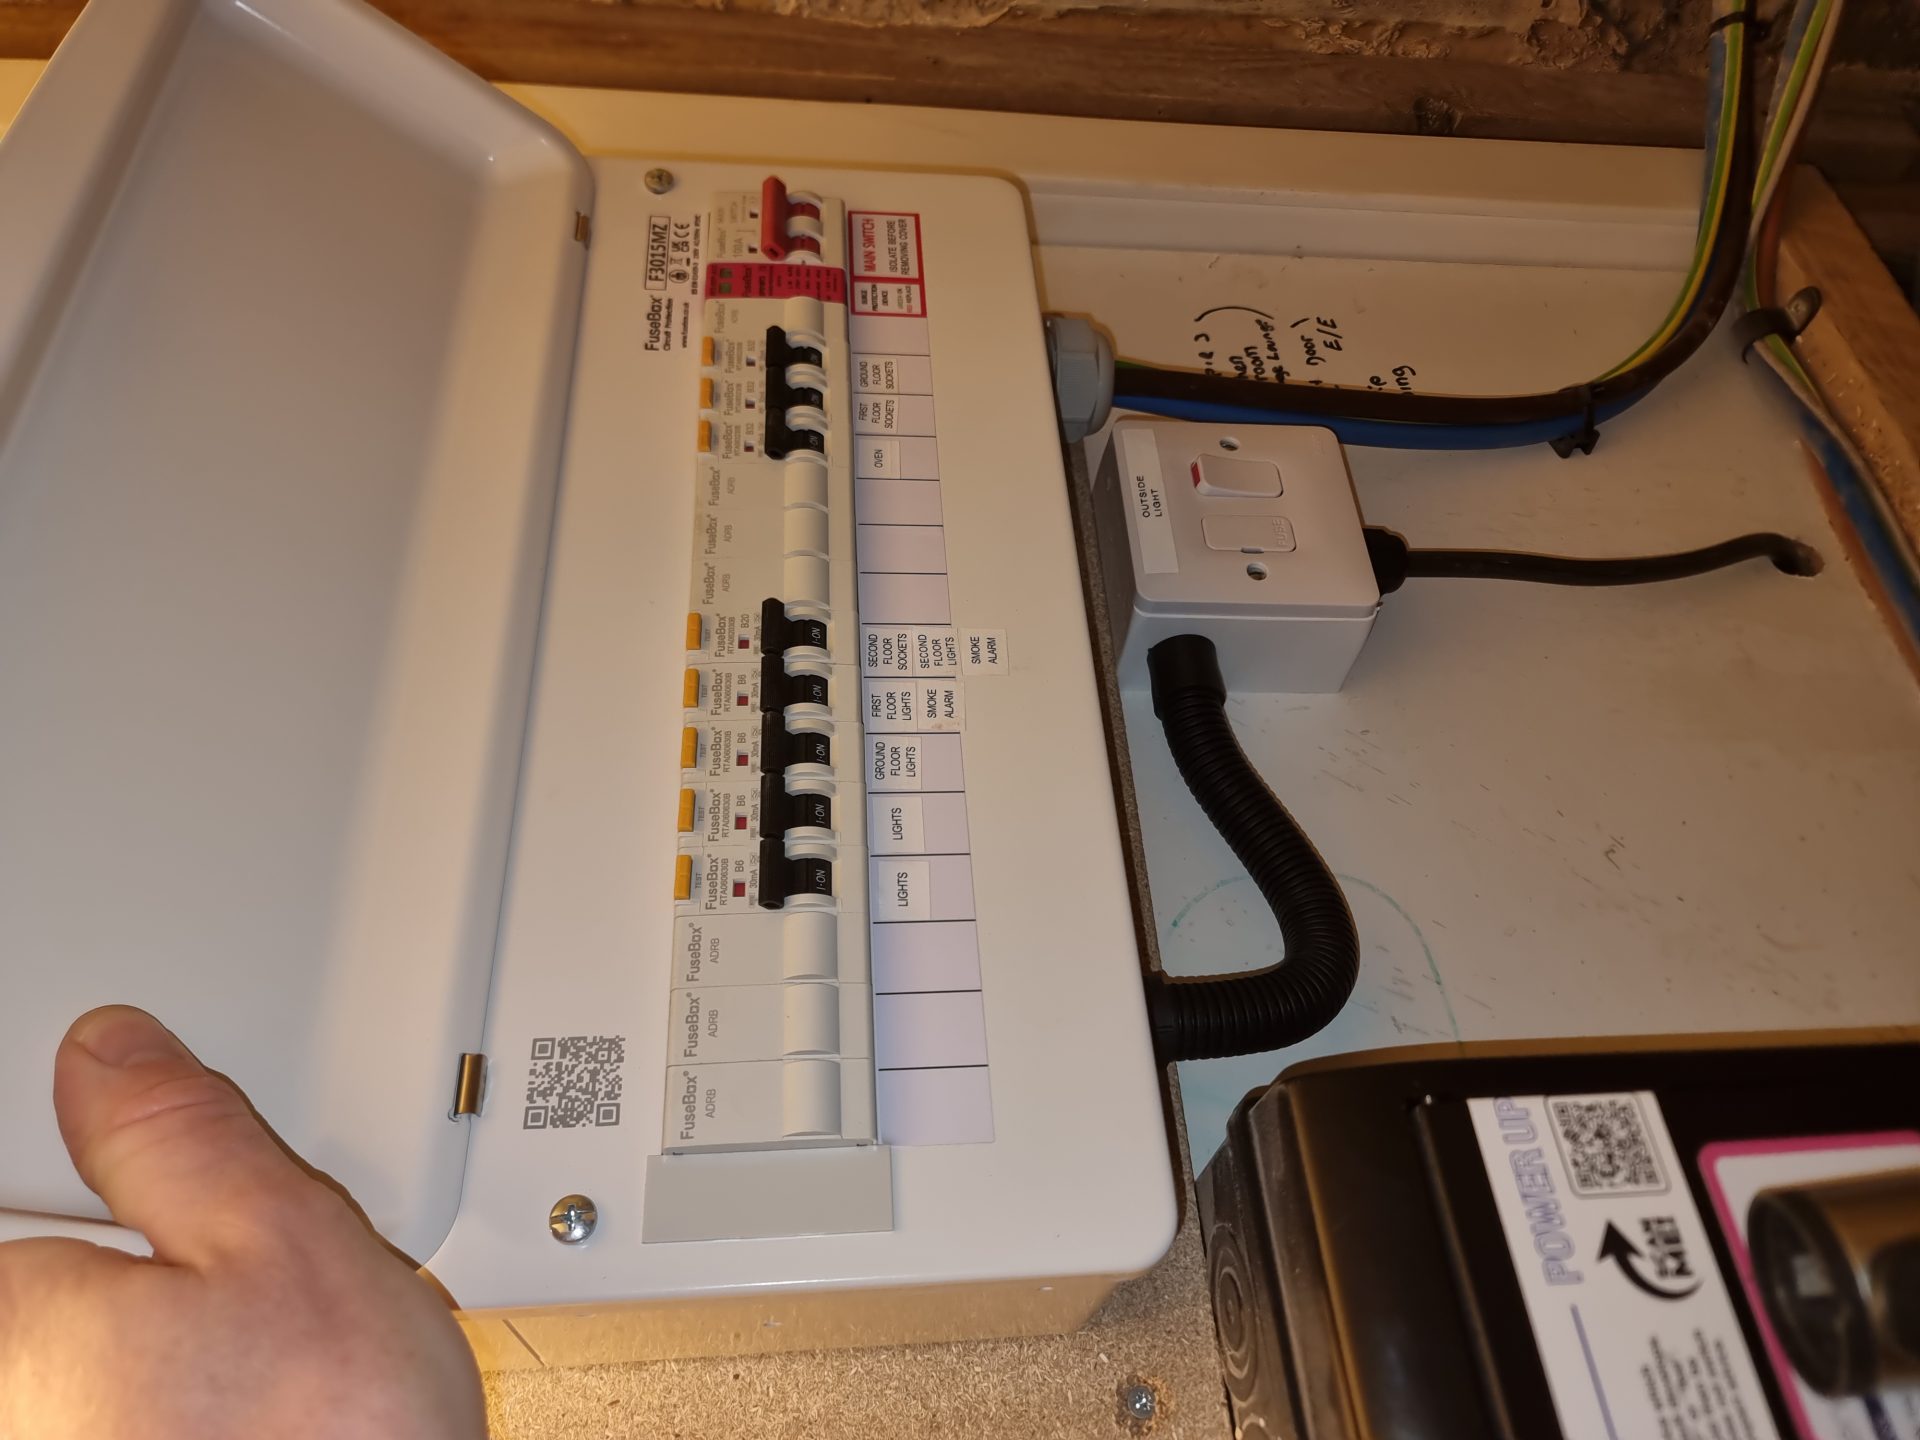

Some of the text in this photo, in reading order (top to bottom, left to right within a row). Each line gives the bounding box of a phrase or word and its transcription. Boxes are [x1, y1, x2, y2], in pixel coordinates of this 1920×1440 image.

[648, 223, 668, 282] F3015MZ
[862, 218, 876, 272] MAIN SWITCH
[886, 220, 898, 272] ISOLATE BEFORE
[898, 218, 910, 275] REMOVING COVER
[664, 298, 673, 351] Circuit Protection
[860, 362, 869, 387] GROUND
[872, 365, 881, 385] FLOOR
[884, 362, 894, 389] SOCKETS
[1244, 346, 1268, 381] room
[858, 403, 868, 420] FIRST
[872, 403, 881, 423] FLOOR
[884, 400, 894, 429] SOCKETS
[874, 449, 883, 468] OVEN
[1136, 475, 1151, 518] OUTSIDE
[1151, 489, 1162, 517] LIGHT
[1272, 519, 1286, 546] FUSE
[722, 574, 730, 592] ADRB
[741, 614, 749, 628] B20
[868, 634, 878, 668] SECOND
[883, 638, 892, 664] FLOOR
[898, 634, 908, 670] SOCKETS
[918, 634, 930, 668] SECOND
[932, 639, 943, 666] FLOOR
[945, 637, 957, 666] LIGHTS
[970, 636, 981, 664] SMOKE
[987, 637, 998, 664] ALARM
[737, 674, 746, 685] B6
[872, 694, 882, 718] FIRST
[886, 692, 897, 720] FLOOR
[901, 692, 911, 721] LIGHTS
[927, 689, 937, 718] SMOKE
[944, 690, 954, 718] ALARM
[737, 732, 746, 743] B6
[751, 741, 759, 758] 30mA
[875, 742, 886, 780] GROUND
[890, 746, 901, 776] FLOOR
[906, 746, 916, 777] LIGHTS
[736, 795, 746, 806] B6
[750, 804, 759, 822] 30mA
[891, 808, 903, 840] LIGHTS
[734, 860, 744, 872] B6
[750, 870, 758, 888] 30mA
[897, 872, 908, 907] LIGHTS
[709, 938, 719, 964] ADRB
[708, 1010, 718, 1038] ADRB
[705, 1089, 716, 1118] ADRB
[1493, 1098, 1584, 1286] POWER UP
